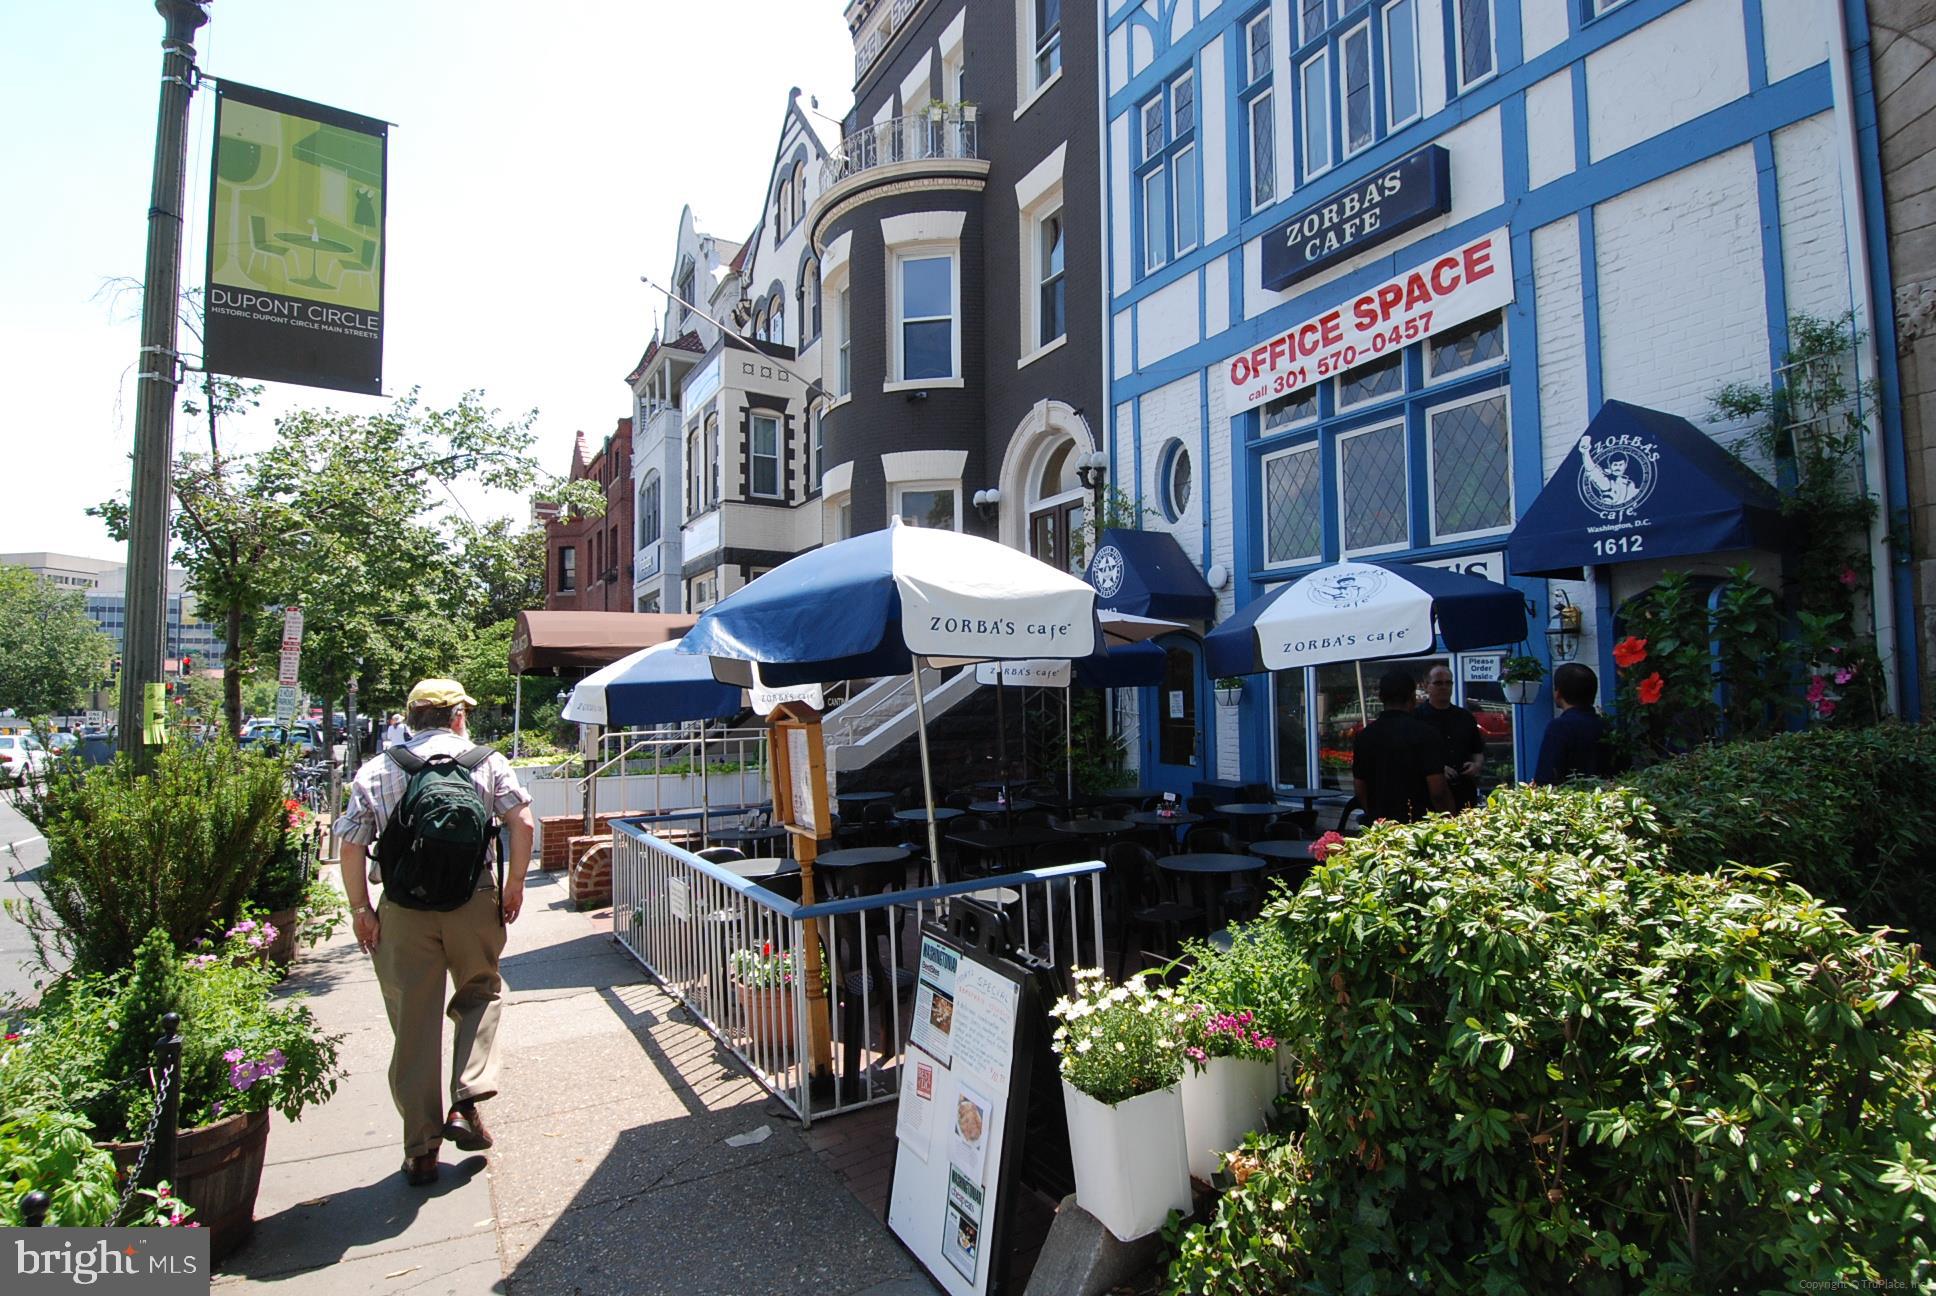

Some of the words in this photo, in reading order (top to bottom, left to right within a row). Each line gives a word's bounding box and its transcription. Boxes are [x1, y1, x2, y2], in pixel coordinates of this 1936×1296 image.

[1286, 169, 1401, 247] ZORBA'S
[1304, 208, 1380, 261] CAFE
[211, 289, 302, 316] DUPONT
[308, 306, 380, 331] CIRCLE
[211, 307, 251, 319] HISTORIC
[253, 312, 288, 325] DUPONT
[290, 319, 320, 330] CIRCLE
[321, 324, 343, 334] MAIN
[344, 328, 379, 340] STREETS
[1230, 310, 1344, 386] OFFICE
[1353, 238, 1494, 332] SPACE
[1248, 387, 1267, 402] call
[1273, 366, 1307, 394] 301
[1317, 311, 1434, 376] 570-0457
[1594, 434, 1660, 461] ZORBA'S
[1587, 522, 1633, 534] Washington,
[1634, 519, 1651, 527] D.C.
[1593, 535, 1643, 556] 1612
[930, 617, 1015, 635] ZORBA'S
[1283, 635, 1356, 653] ZORBA'S
[990, 667, 1031, 676] ZRBA'S
